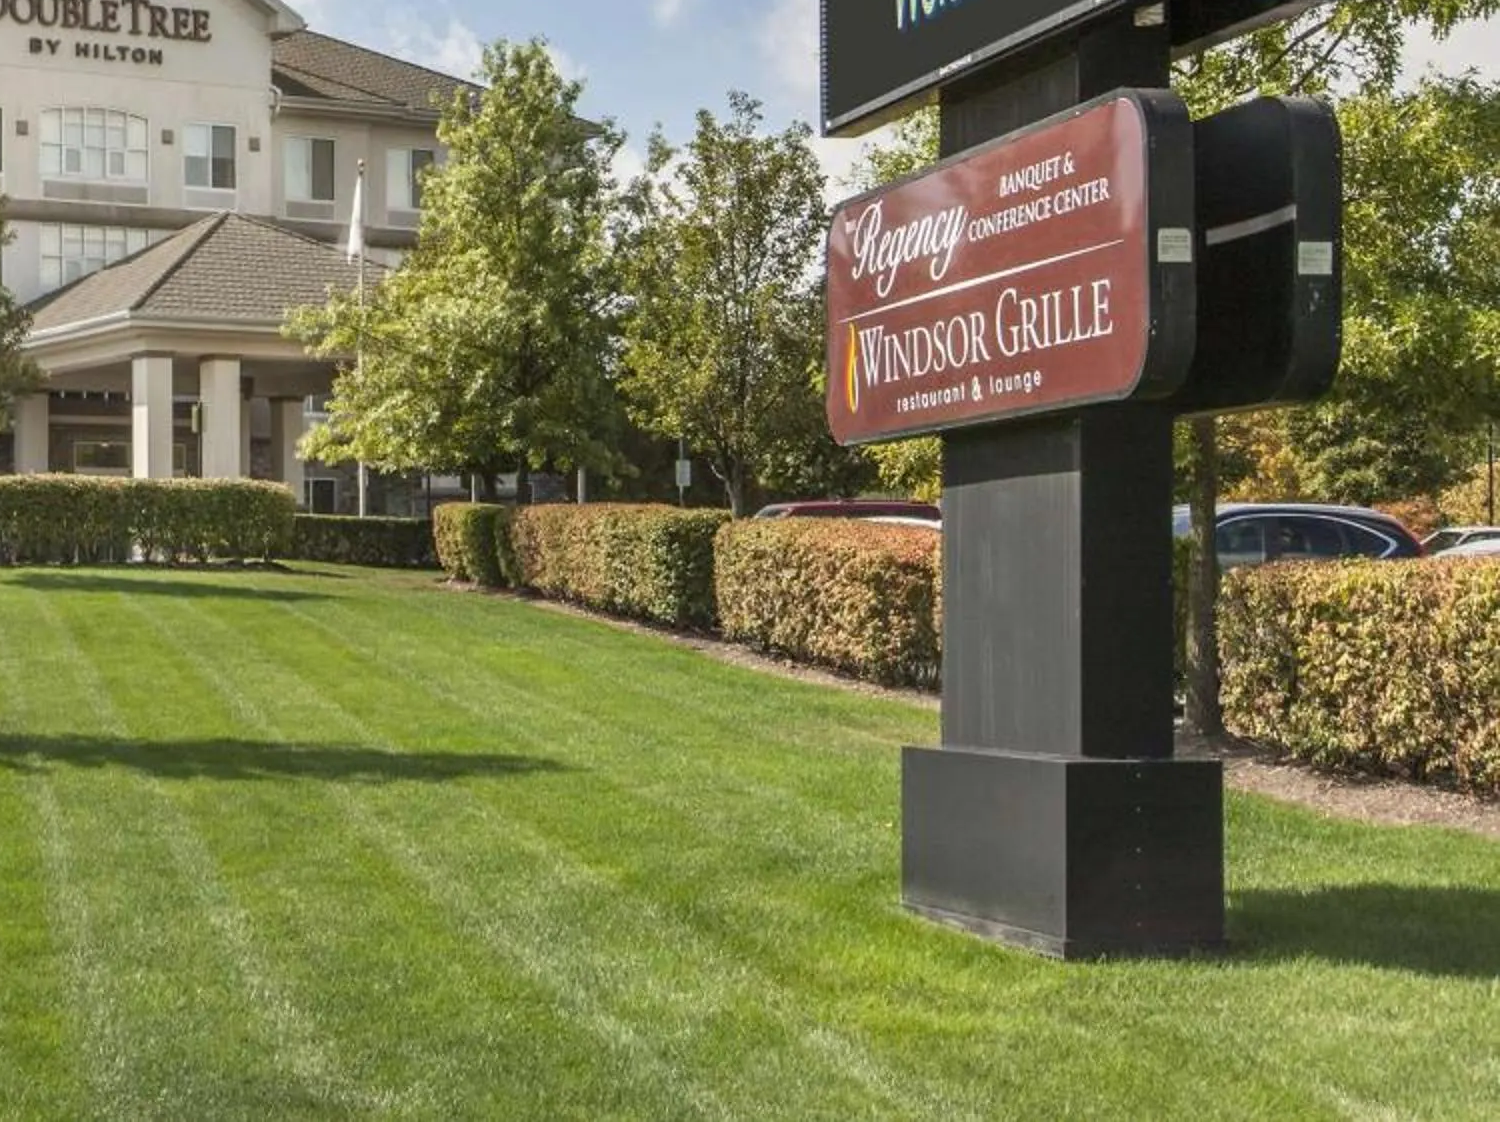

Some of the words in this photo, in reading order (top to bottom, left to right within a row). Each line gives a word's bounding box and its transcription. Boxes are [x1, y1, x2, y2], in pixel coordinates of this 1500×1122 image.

[29, 38, 61, 55] BY
[75, 42, 163, 65] HILTON
[999, 155, 1061, 197] BANQUET
[1063, 151, 1075, 175] &
[967, 196, 1052, 242] CONFERENCE
[1053, 177, 1110, 215] CENTER
[851, 198, 969, 298] Regency
[858, 311, 991, 388] WINDSOR
[995, 279, 1113, 358] GRILLE
[896, 386, 965, 413] restaurant
[971, 376, 983, 402] &
[989, 370, 1042, 395] lounge
